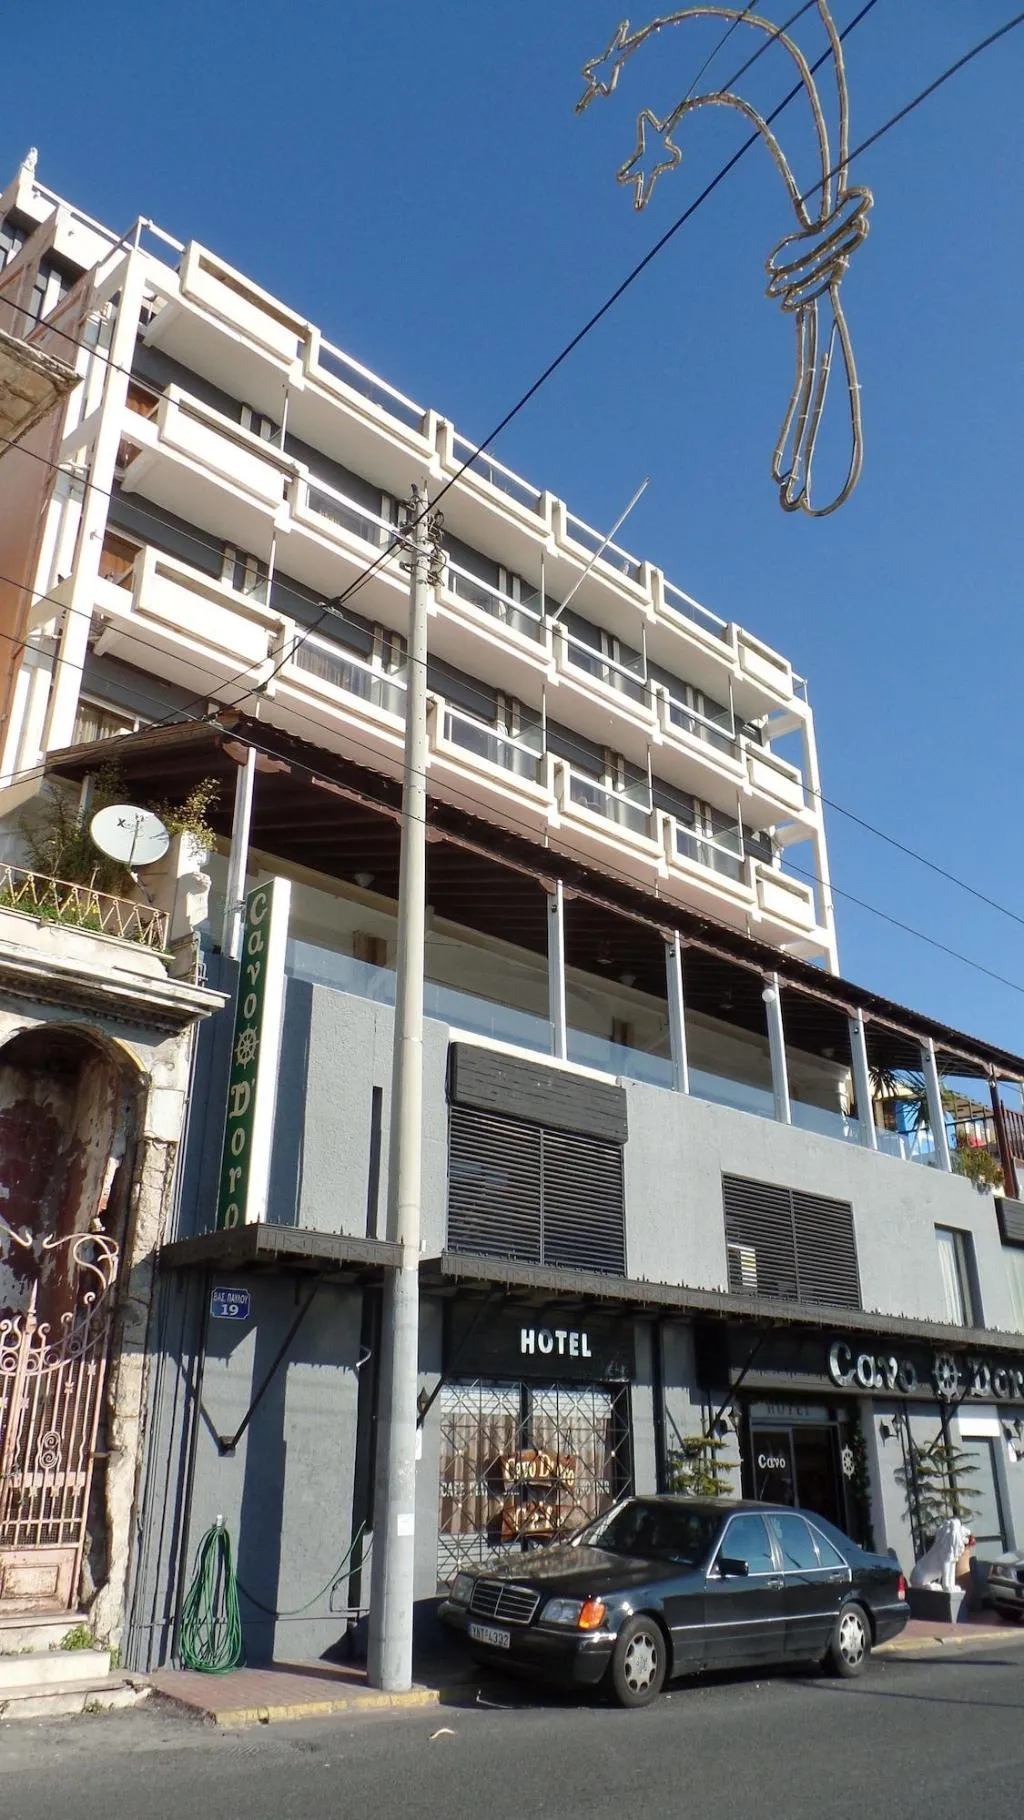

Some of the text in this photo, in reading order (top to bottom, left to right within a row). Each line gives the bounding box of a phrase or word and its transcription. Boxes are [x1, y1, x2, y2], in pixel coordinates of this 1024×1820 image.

[242, 892, 270, 1019] Cavo
[220, 1304, 239, 1316] 19
[520, 1328, 592, 1358] HOTEL
[829, 1341, 917, 1392] Cavo
[757, 1454, 787, 1470] Cavo
